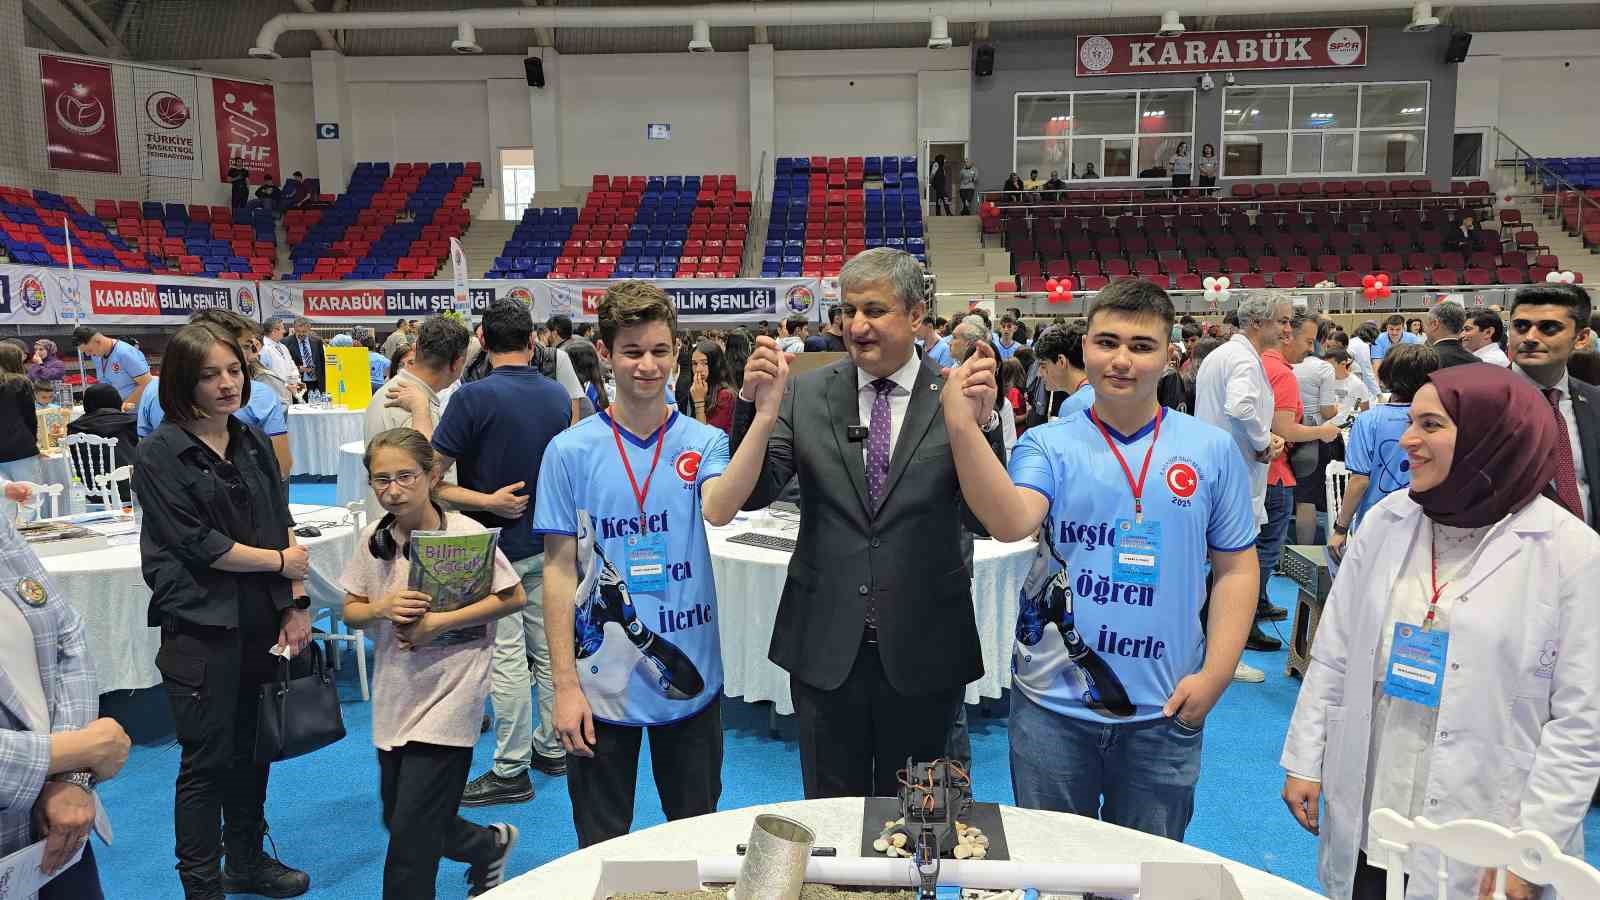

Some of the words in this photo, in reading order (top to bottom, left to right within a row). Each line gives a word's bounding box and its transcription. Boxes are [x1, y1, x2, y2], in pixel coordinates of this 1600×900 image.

[1129, 33, 1312, 66] KARABÜK
[1330, 42, 1360, 50] SPOR
[146, 132, 193, 146] TÜRKİYE
[321, 124, 336, 138] C
[227, 143, 271, 161] THF
[95, 287, 157, 308] KARABÜK
[160, 288, 192, 309] BİLİM
[308, 293, 383, 311] KARABÜK
[387, 292, 427, 310] BİLİM
[711, 290, 770, 312] ŞENLİĞİ
[1076, 569, 1154, 606] Öğren
